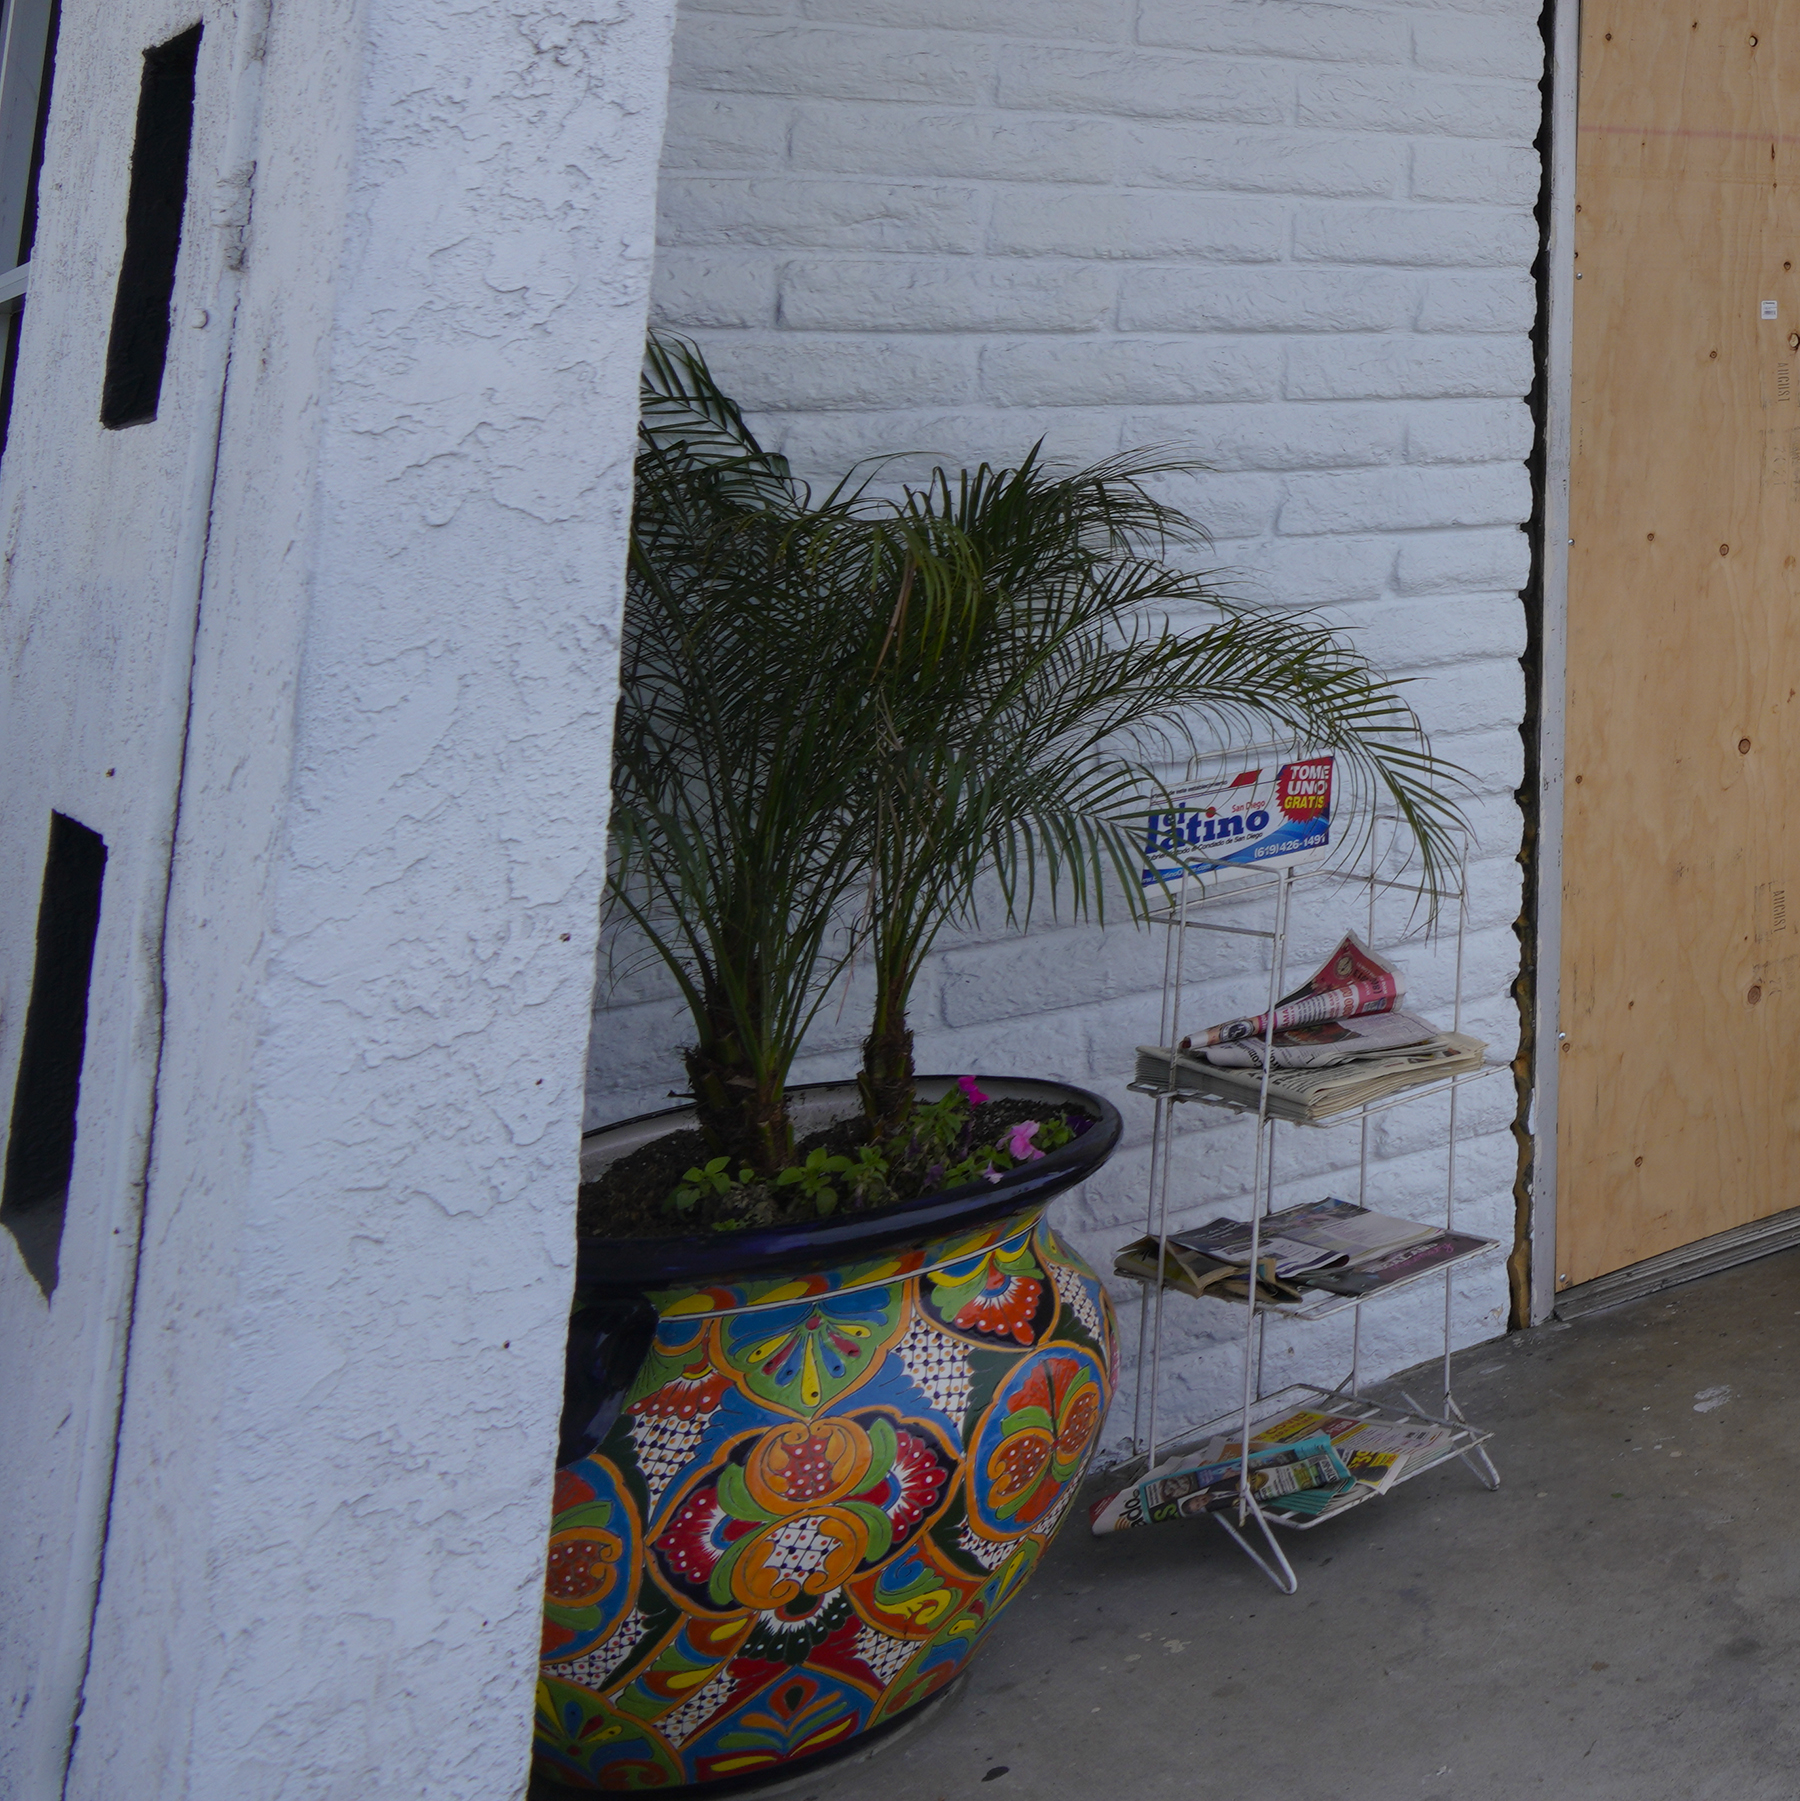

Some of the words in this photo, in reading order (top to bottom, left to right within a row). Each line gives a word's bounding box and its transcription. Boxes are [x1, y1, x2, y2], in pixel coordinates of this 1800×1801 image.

[1289, 765, 1331, 780] TOME
[1287, 780, 1328, 795] UNO
[1231, 804, 1245, 814] San
[1245, 800, 1266, 812] Diego
[1283, 795, 1326, 810] GRATIS
[1198, 840, 1225, 850] Condado
[1225, 837, 1234, 845] de
[1234, 835, 1245, 844] San
[1245, 832, 1264, 842] Diego
[1254, 843, 1280, 859] (619)
[1279, 833, 1326, 852] 426-1491
